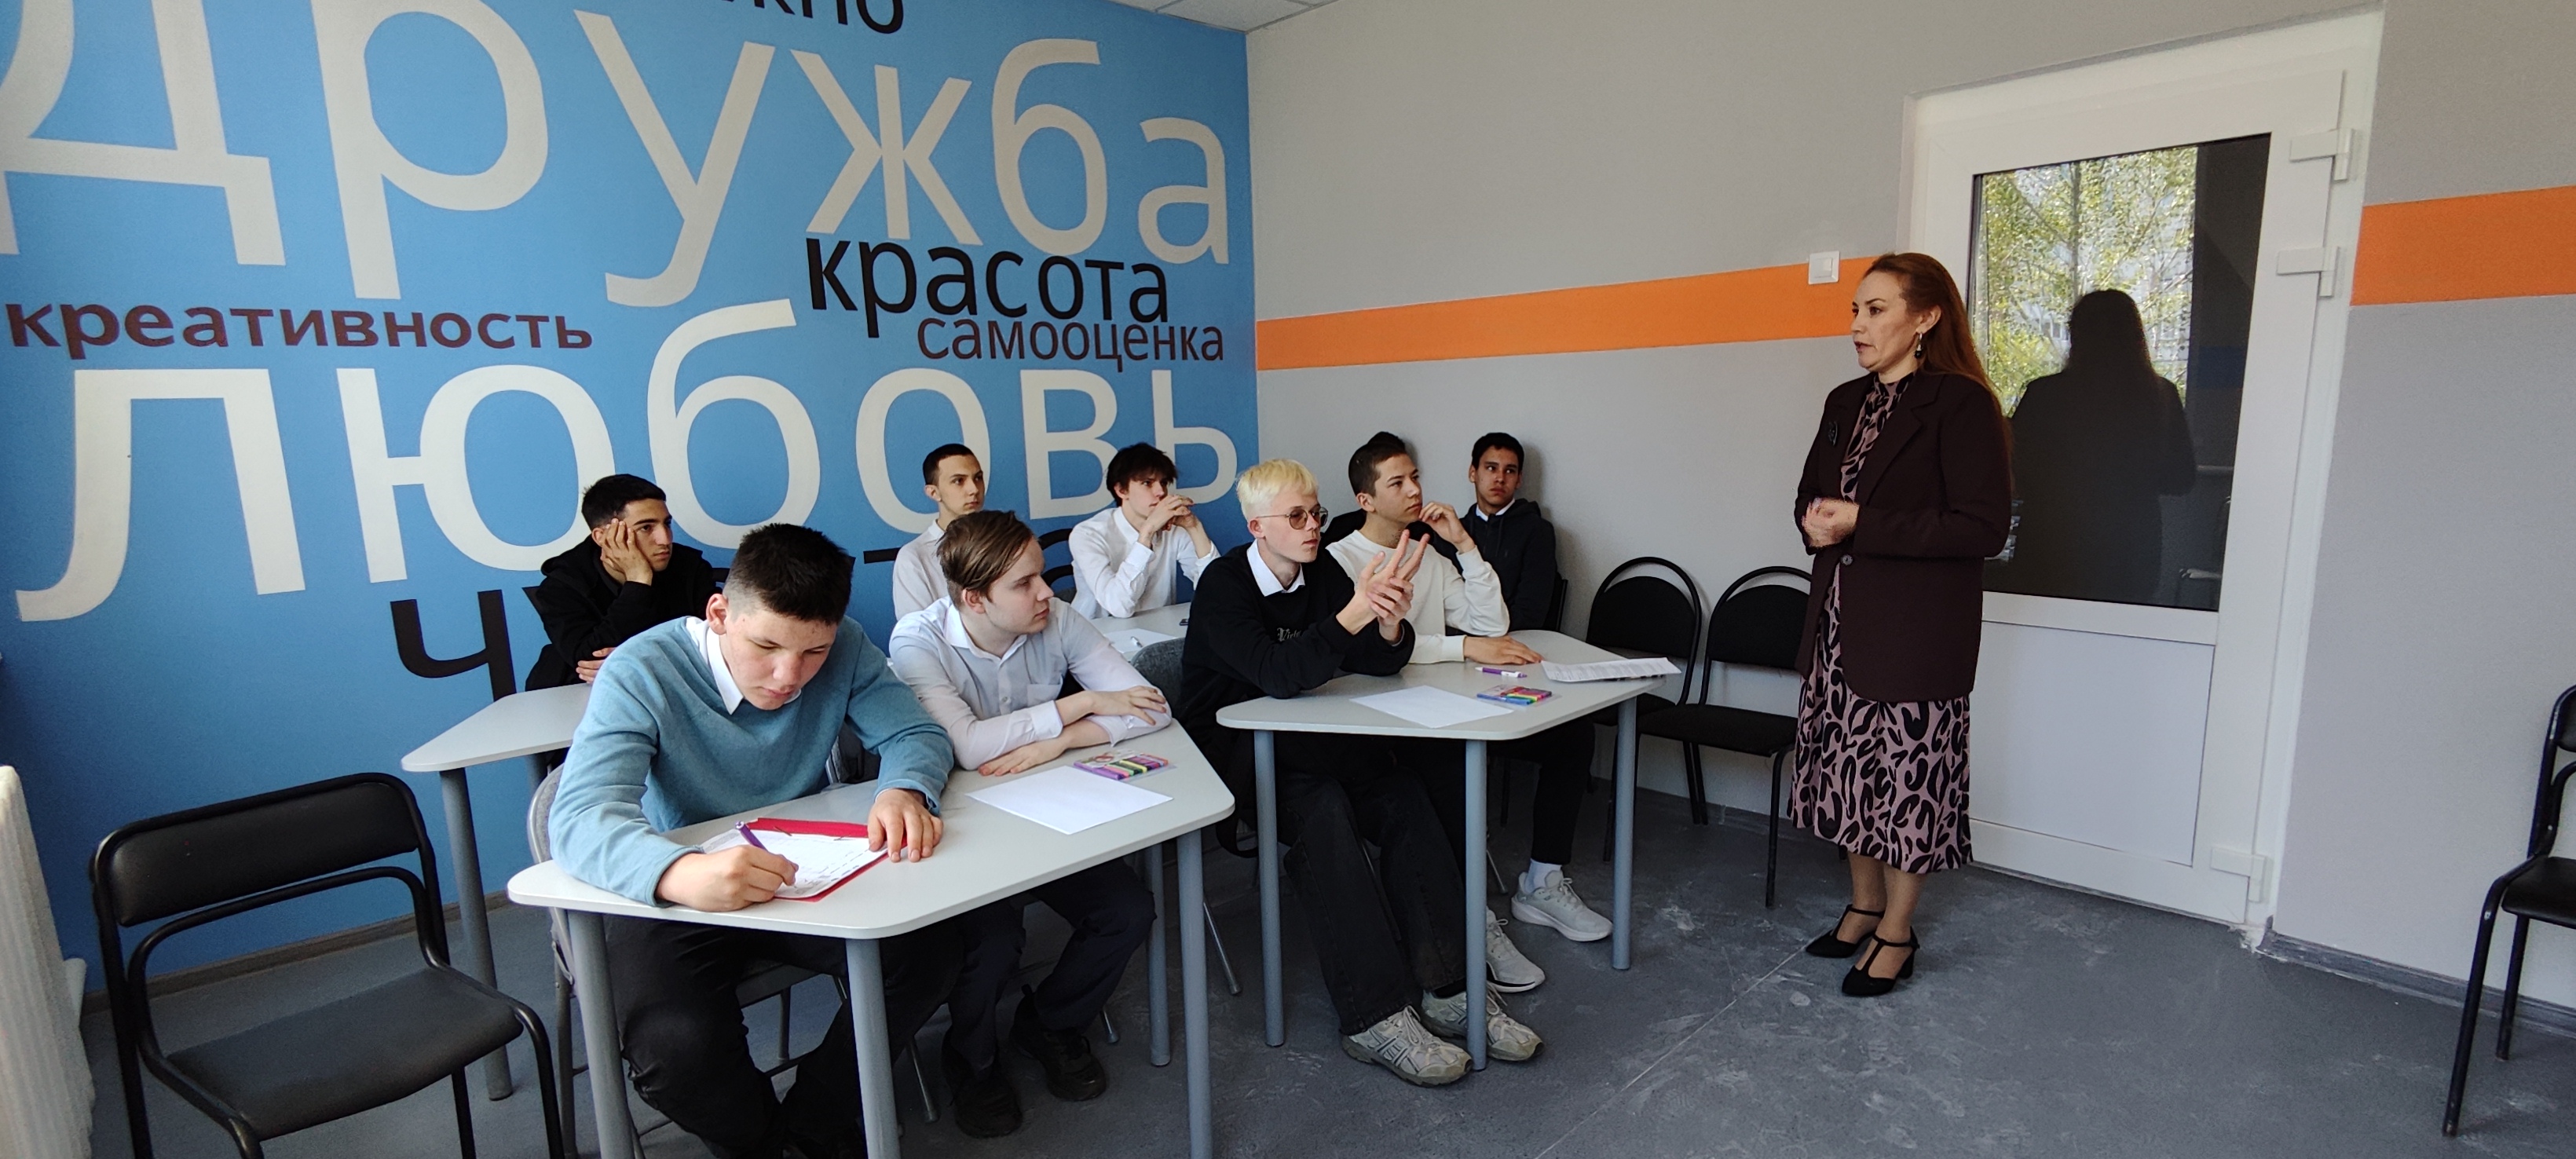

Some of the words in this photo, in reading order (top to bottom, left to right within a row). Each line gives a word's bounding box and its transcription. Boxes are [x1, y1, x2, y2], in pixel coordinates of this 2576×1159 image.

[806, 238, 1169, 338] красота
[5, 302, 593, 360] креативность
[917, 316, 1224, 372] самооценка
[16, 298, 1239, 622] любовь
